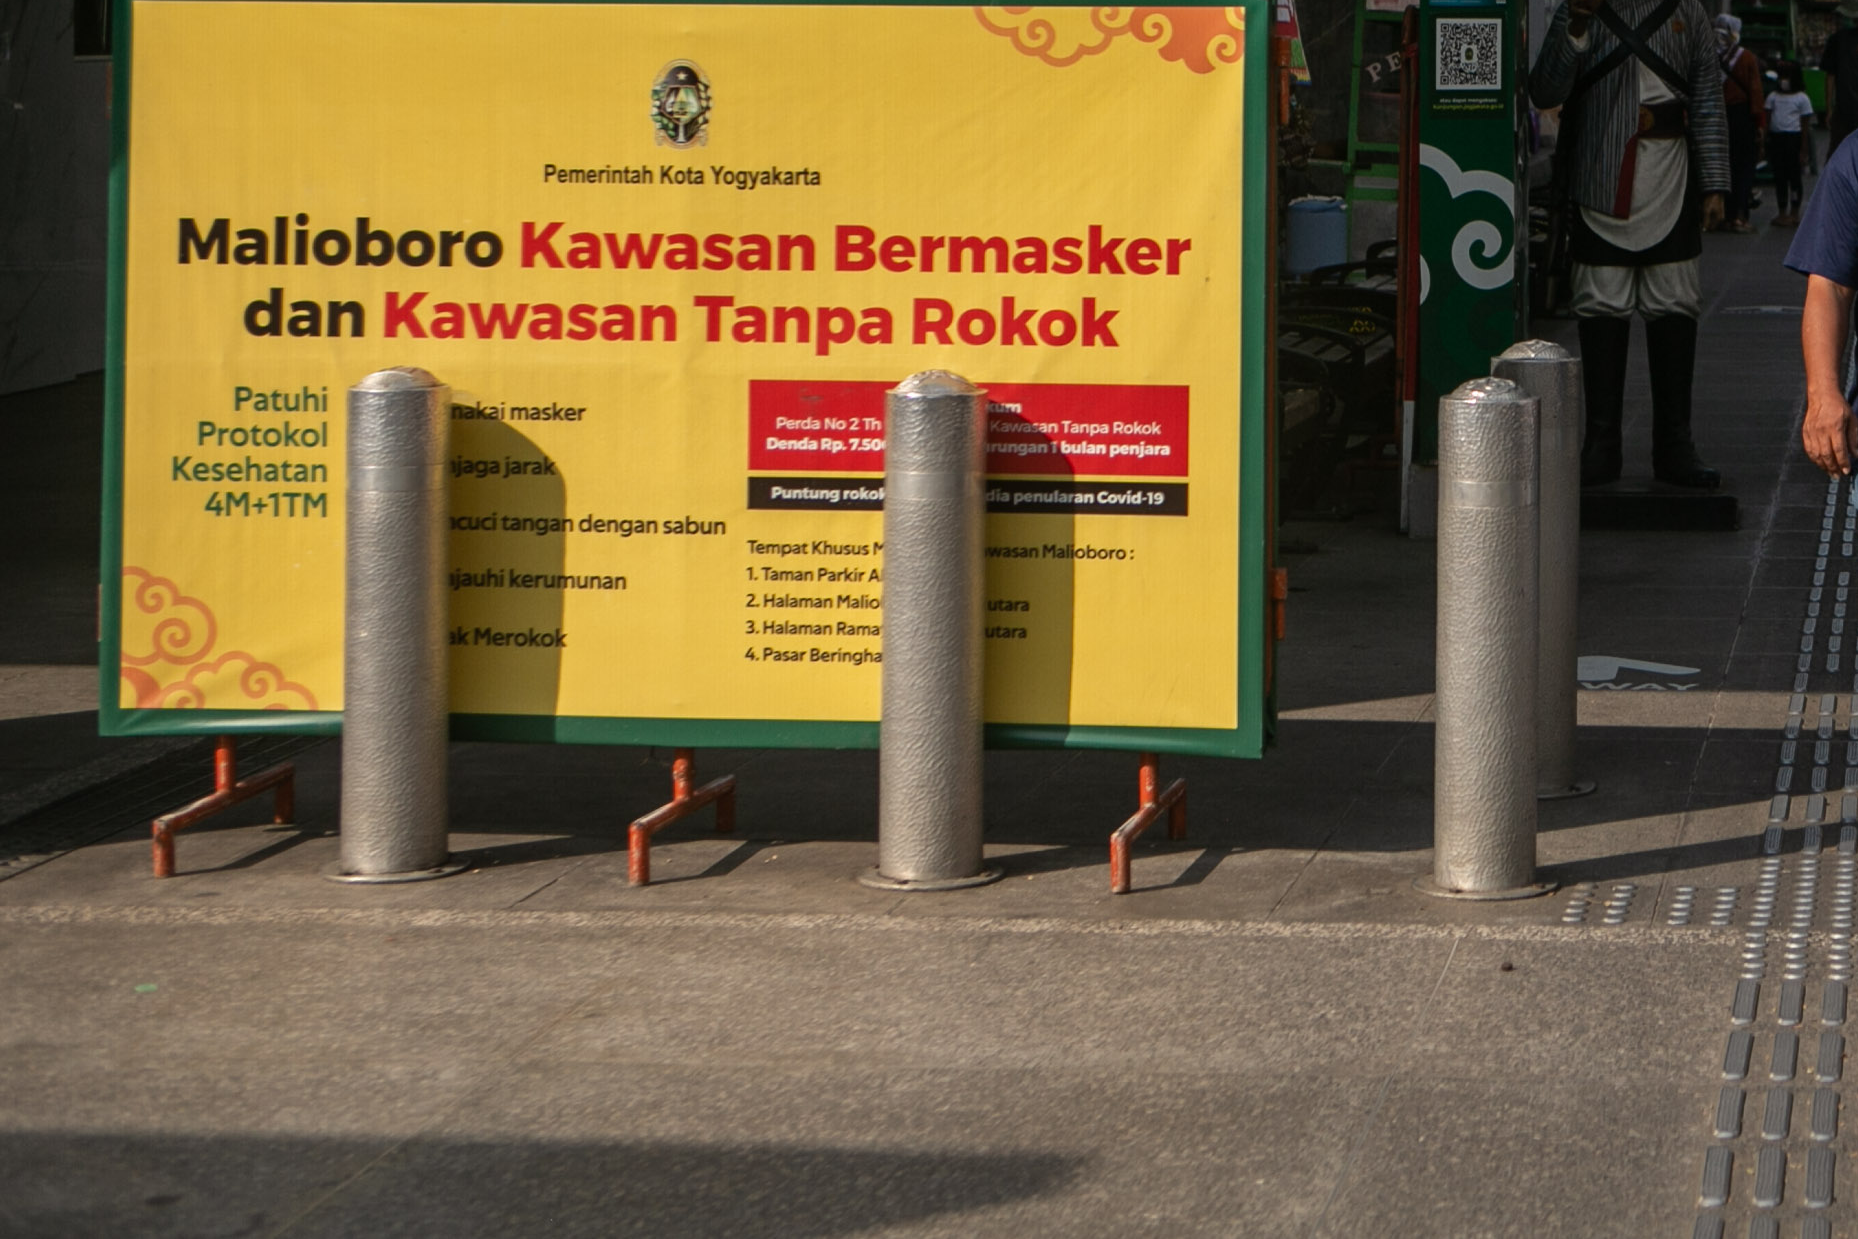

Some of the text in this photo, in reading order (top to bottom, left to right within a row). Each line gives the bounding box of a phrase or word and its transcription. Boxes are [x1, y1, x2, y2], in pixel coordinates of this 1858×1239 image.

[543, 164, 821, 190] Pemerintah Kota Yogyakarta
[177, 213, 1192, 276] Malioboro Kawasan Bermasker
[243, 287, 1120, 356] dan Kawasan Tanpa Rokok
[234, 385, 328, 412] Patuhi
[510, 402, 586, 421] masker
[198, 421, 328, 448] Protokol
[776, 416, 1162, 436] Perda No 2 Th Kawasan Tanpa Rokok
[766, 437, 818, 450] Denda
[820, 438, 847, 454] Rp.
[1051, 441, 1058, 453] 1
[1060, 441, 1106, 455] bulan
[1109, 442, 1170, 458] penjara
[171, 456, 328, 483] Kesehatan
[503, 457, 557, 478] jarak
[204, 491, 328, 518] 4M+1TM
[771, 486, 841, 503] Puntung
[1013, 491, 1094, 505] penularan
[1096, 490, 1164, 505] Covid-19
[502, 514, 574, 536] tangan
[578, 514, 658, 537] dengan
[662, 515, 727, 536] sabun
[747, 539, 809, 557] Tempat
[811, 540, 869, 556] Khusus
[1042, 544, 1126, 560] Malioboro
[509, 569, 627, 590] kerumunan
[746, 567, 758, 581] 1.
[761, 567, 814, 581] Taman
[817, 567, 865, 582] Parkir
[745, 593, 1030, 612] 2. Halaman Malio utara
[473, 627, 568, 648] Merokok
[745, 620, 1027, 639] 3. Halaman Rama utara
[745, 647, 882, 666] 4. Pasar Beringha
